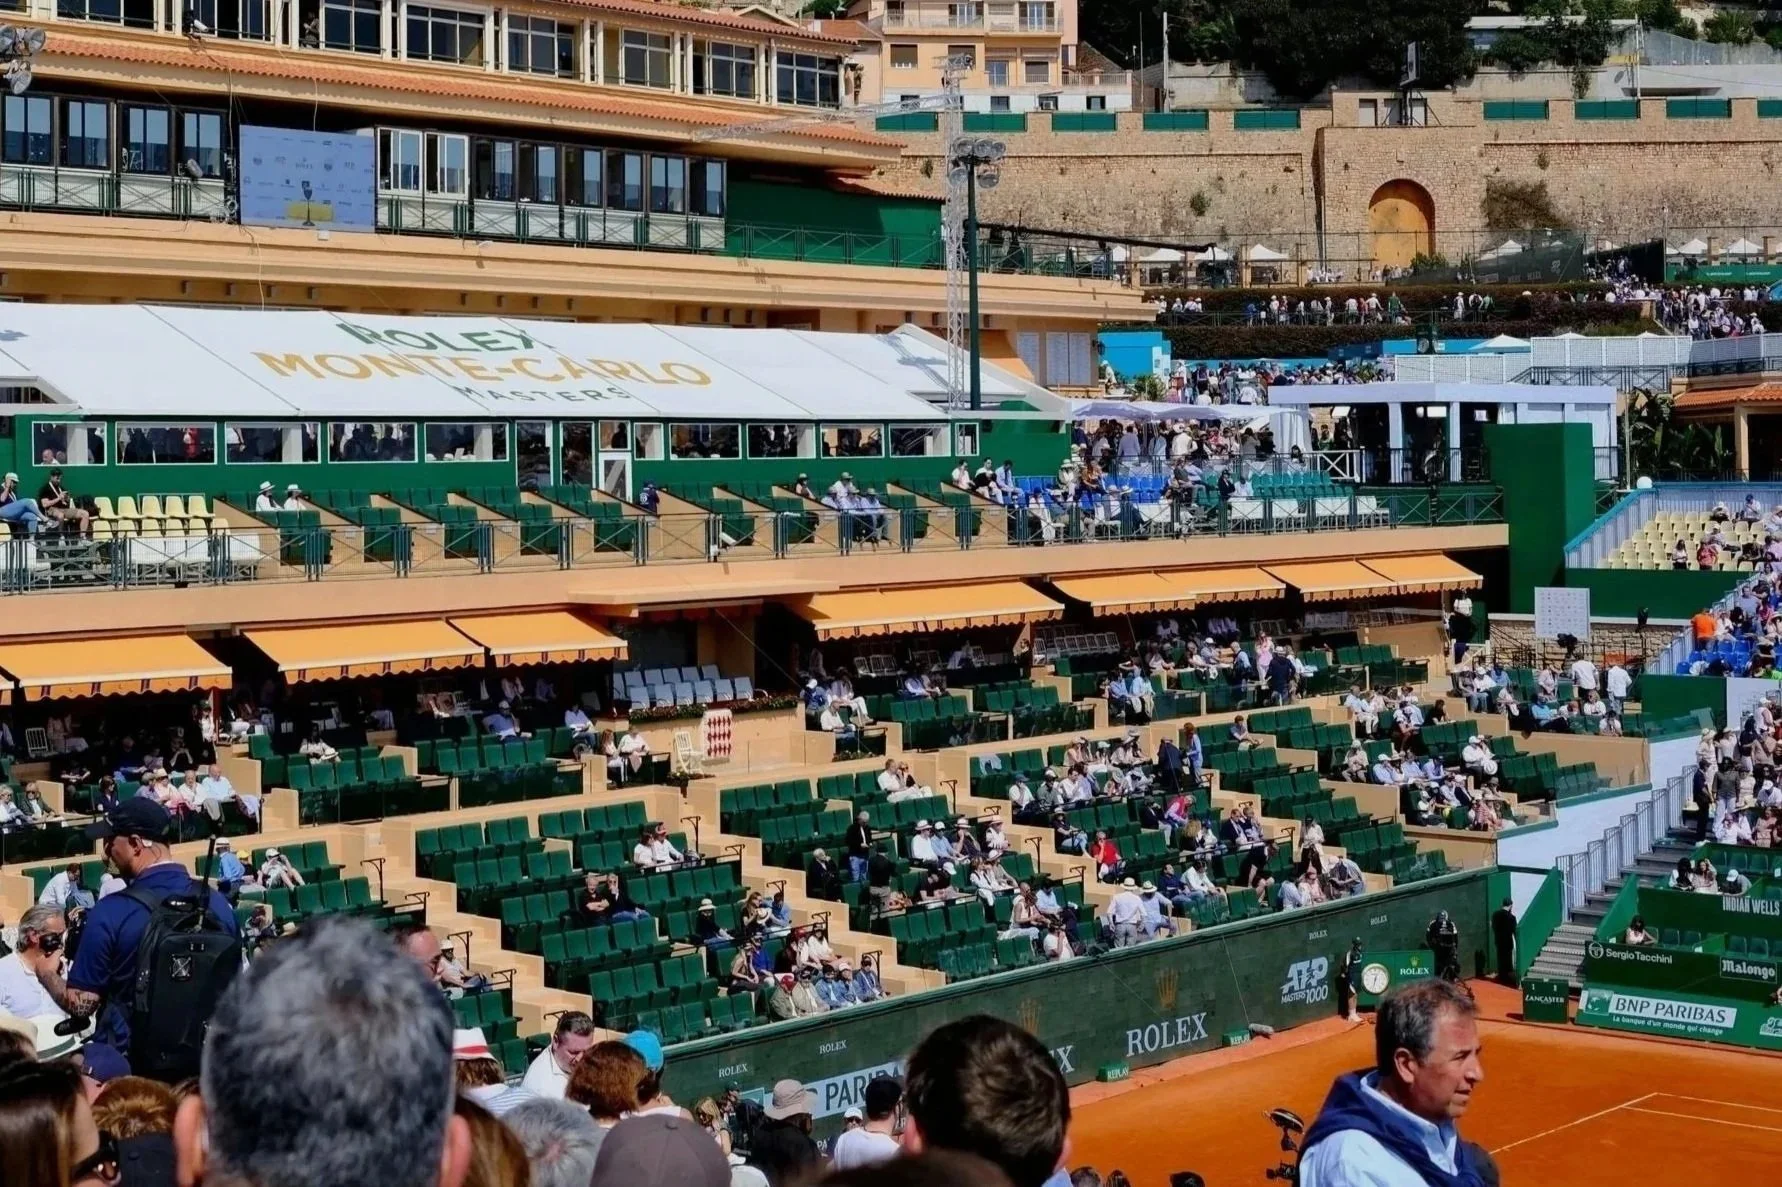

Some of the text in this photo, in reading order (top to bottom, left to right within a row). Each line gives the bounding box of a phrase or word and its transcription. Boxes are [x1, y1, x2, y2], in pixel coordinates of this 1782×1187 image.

[336, 323, 535, 351] ROLEX
[250, 351, 712, 386] MONTE-CARLO
[451, 385, 632, 402] MASTERS
[1723, 896, 1780, 916] INDIAN WELLS
[1309, 930, 1328, 940] ROLEX
[1606, 948, 1673, 965] Sergio Tacchini
[1280, 956, 1329, 993] ATP
[1400, 967, 1430, 976] ROLEX
[1722, 959, 1775, 980] Malongo
[1281, 985, 1329, 1004] MASTERS 1000
[1525, 994, 1565, 1003] LANCASTER
[1615, 998, 1726, 1024] BNP PARIBAS
[1126, 1012, 1208, 1058] ROLEX
[1663, 1022, 1685, 1030] monde
[1687, 1024, 1698, 1033] qui
[1699, 1026, 1724, 1036] change
[820, 1040, 847, 1054] ROLEX
[1230, 1032, 1251, 1046] REPLAY
[719, 1063, 749, 1078] ROLEX
[1107, 1066, 1129, 1080] REPLAY
